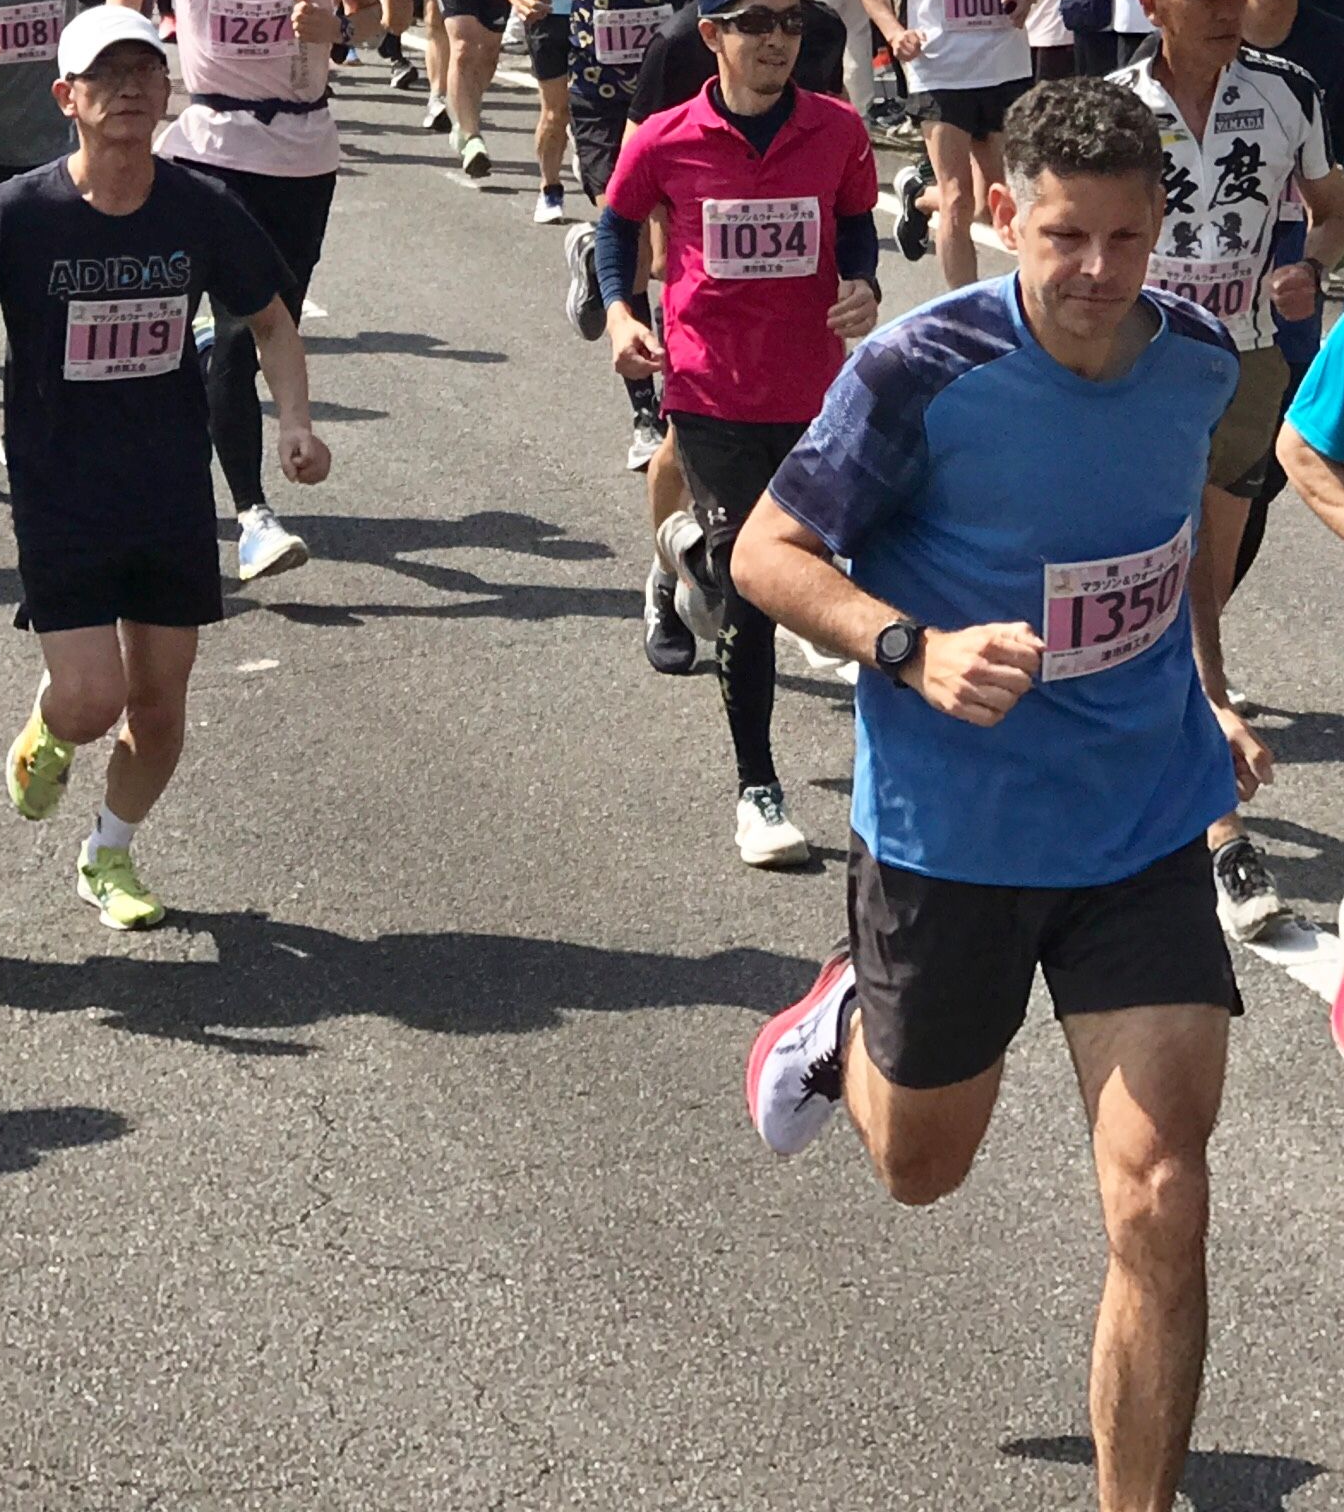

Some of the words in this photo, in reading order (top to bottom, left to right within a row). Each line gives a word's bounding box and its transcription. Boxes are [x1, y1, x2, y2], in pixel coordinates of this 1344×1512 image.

[1, 17, 58, 50] 1081
[219, 15, 287, 45] 1267
[720, 221, 807, 260] 1034
[48, 250, 191, 295] ADIDAS
[87, 320, 171, 360] 1119
[1071, 562, 1180, 649] 1350
